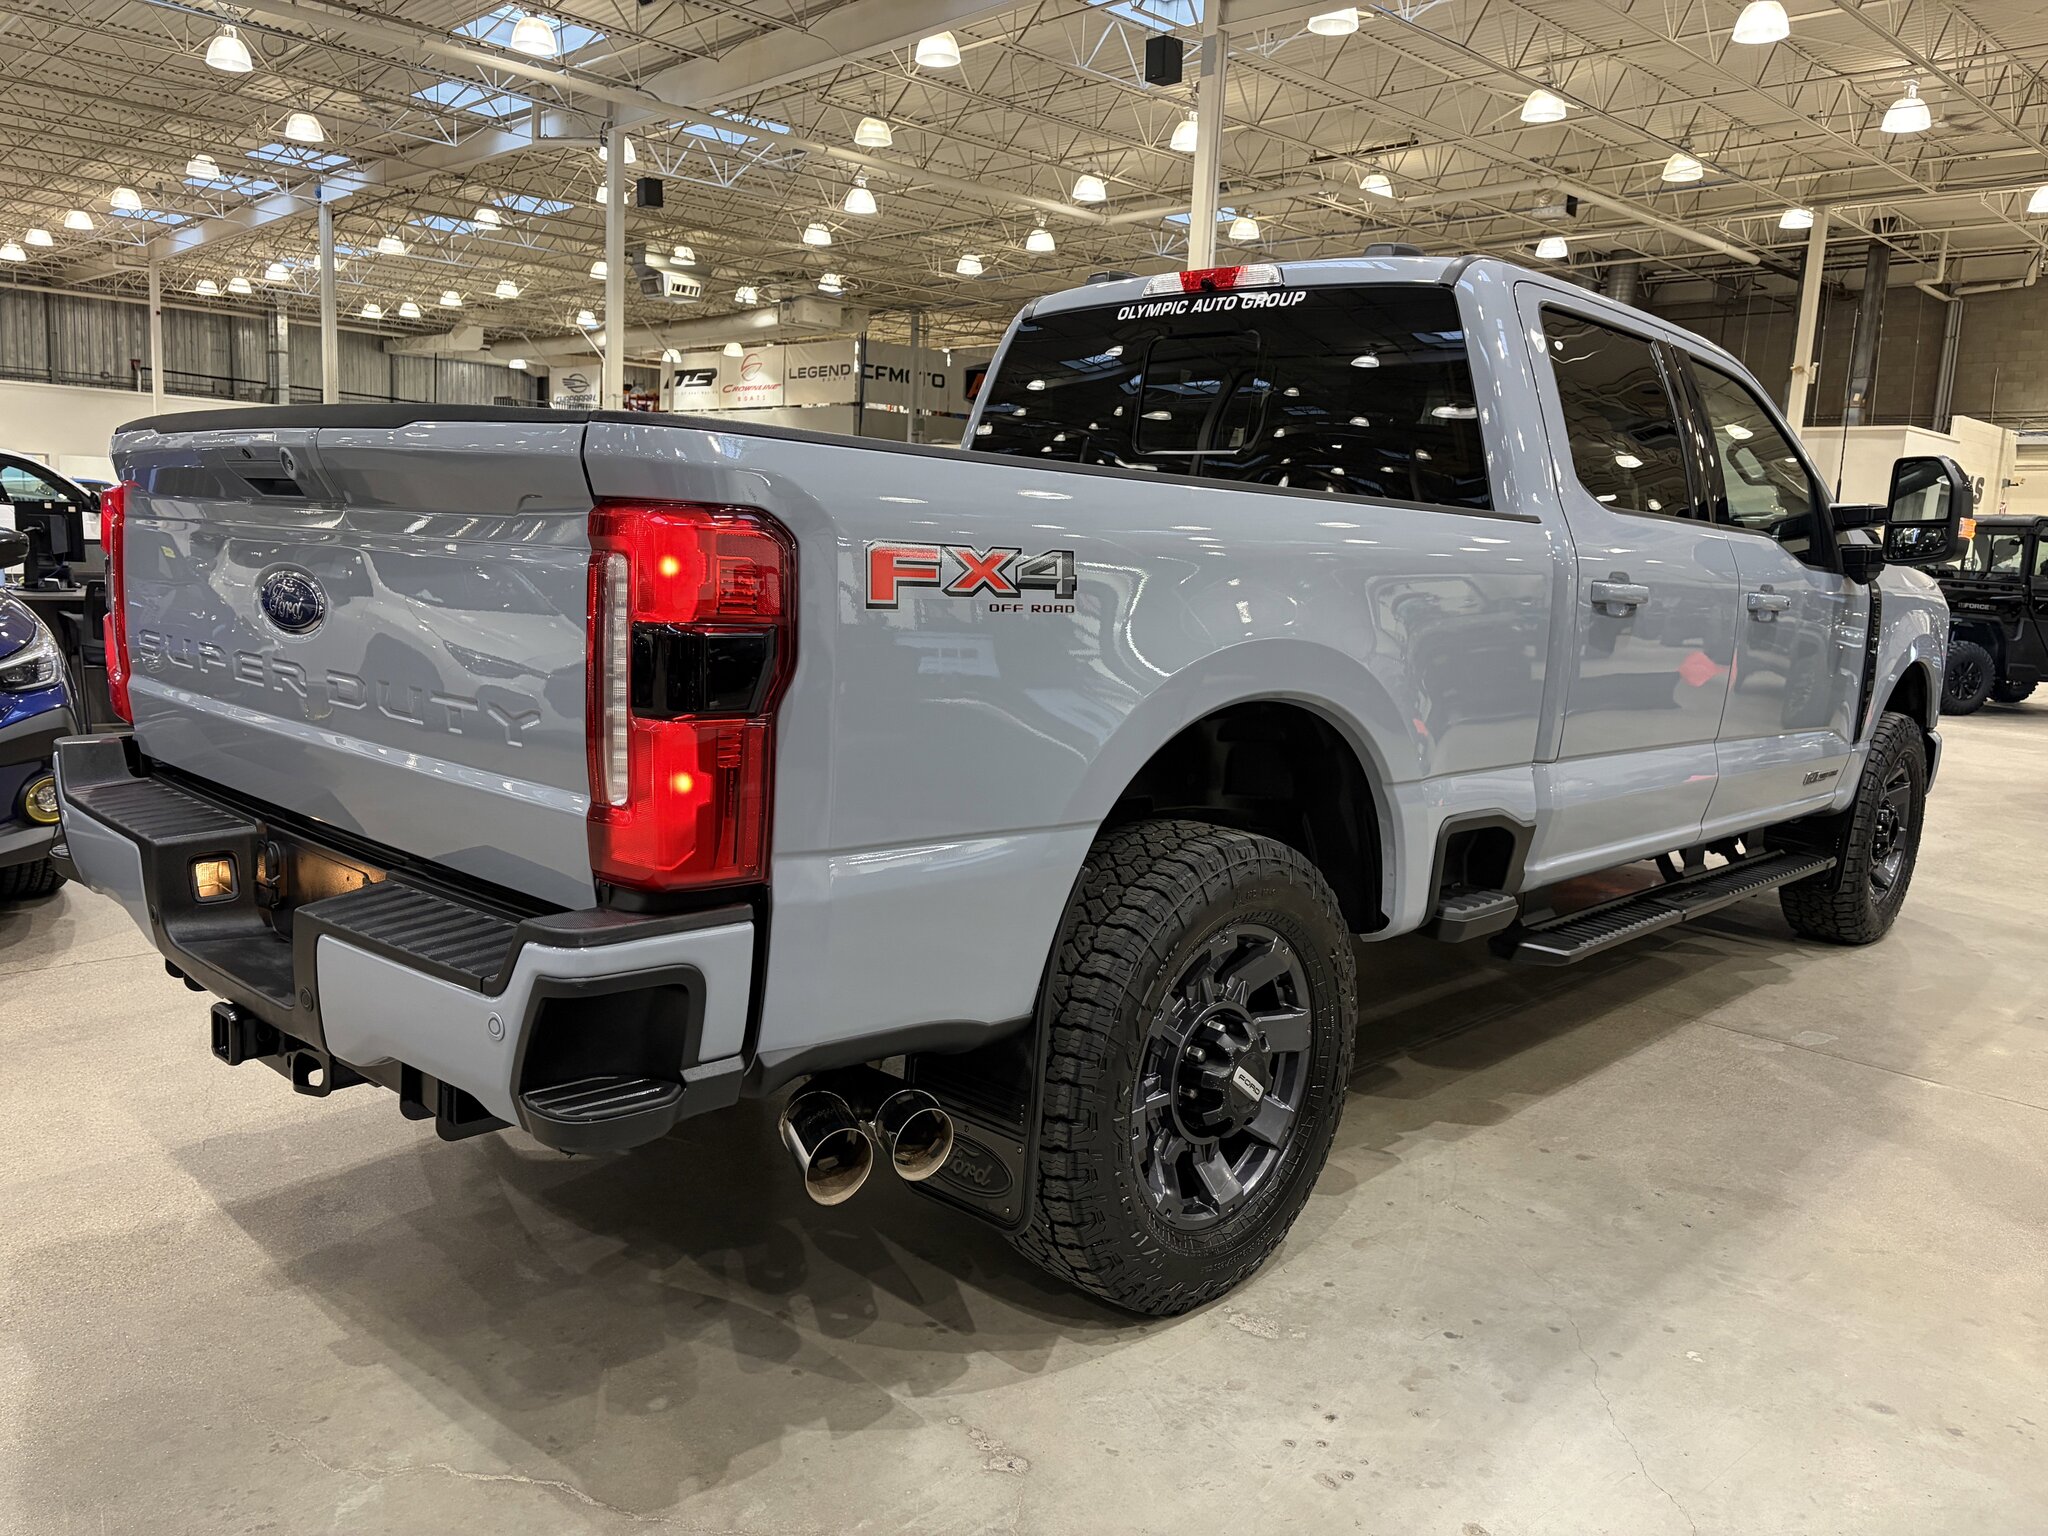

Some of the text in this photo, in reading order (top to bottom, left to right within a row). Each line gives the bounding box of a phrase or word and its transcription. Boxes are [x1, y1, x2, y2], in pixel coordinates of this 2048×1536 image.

[1117, 291, 1306, 321] OLYMPIC AUTO GROUP
[788, 363, 851, 380] LEGEND
[865, 539, 1077, 611] FX4
[269, 583, 304, 621] Ford
[989, 603, 1075, 614] OFF ROAD
[138, 628, 542, 748] SUPER DUTY
[1238, 1073, 1261, 1096] FORD
